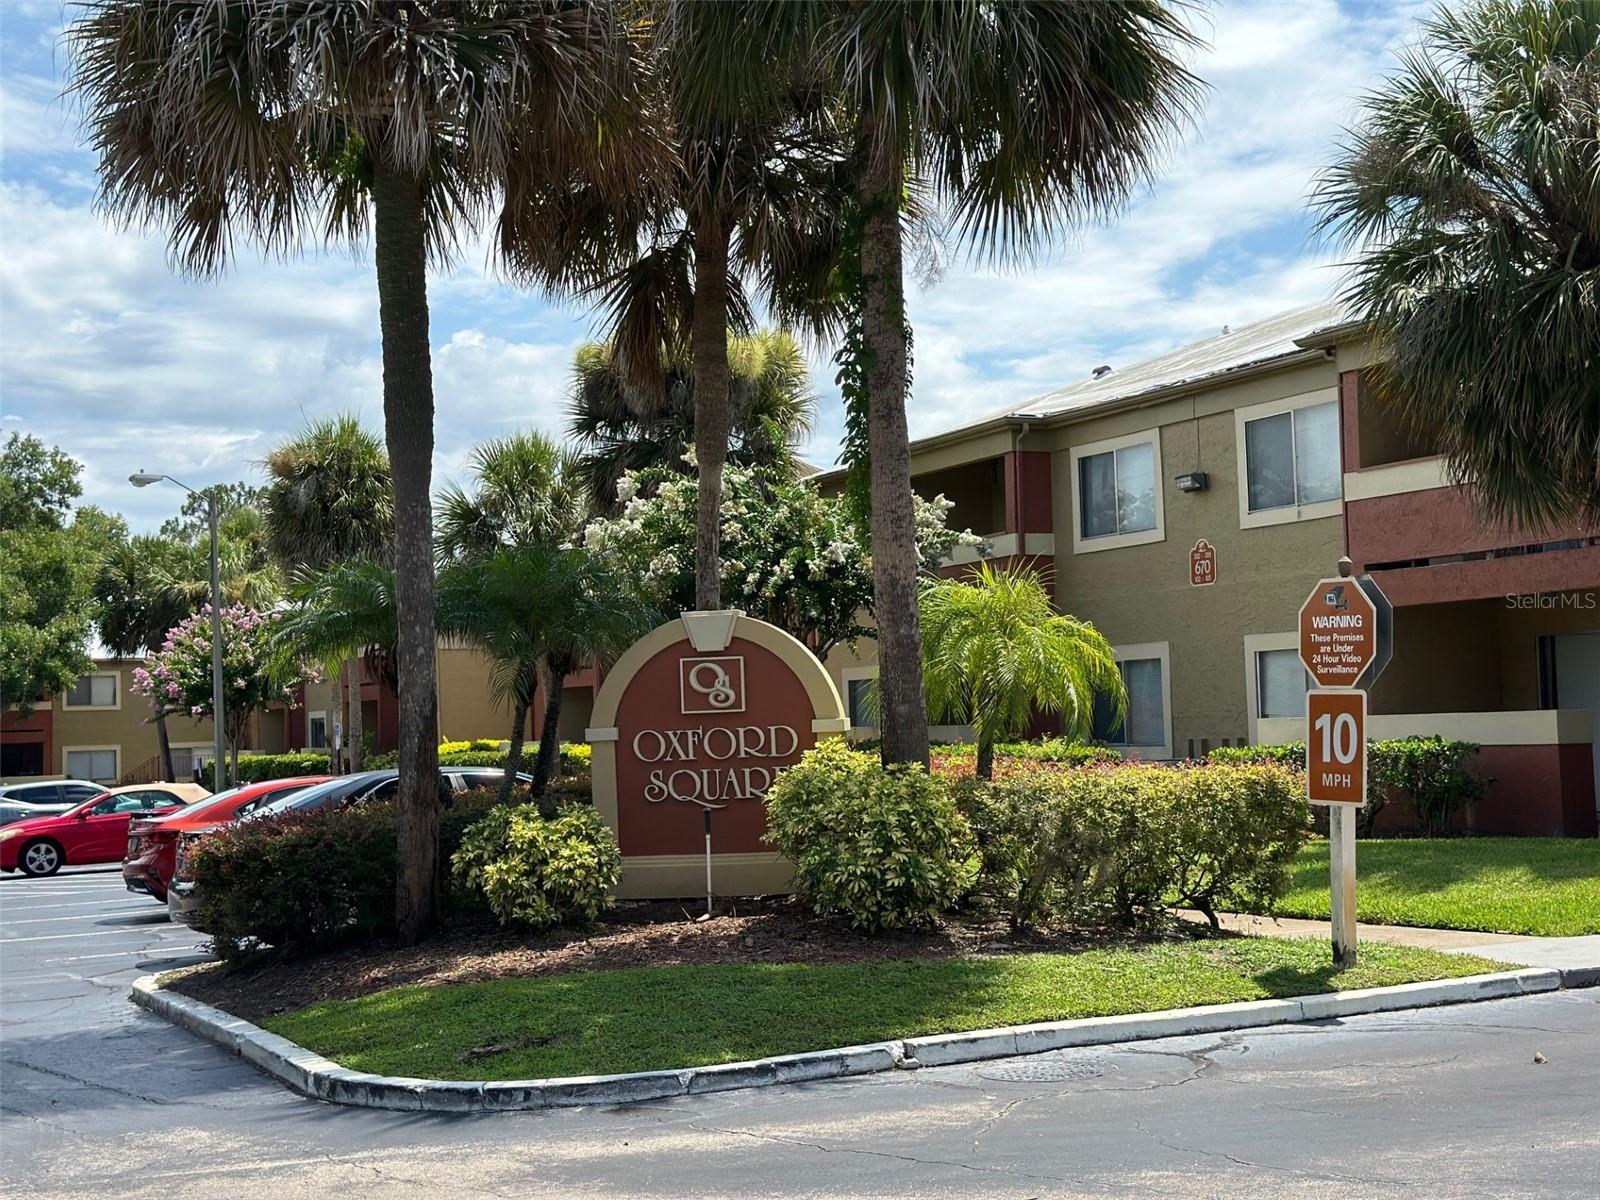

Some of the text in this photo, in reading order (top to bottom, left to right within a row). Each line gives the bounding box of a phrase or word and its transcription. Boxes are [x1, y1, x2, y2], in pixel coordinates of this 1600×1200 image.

[1195, 559, 1211, 575] 670
[1312, 614, 1362, 629] WARNING
[1310, 633, 1364, 642] These Premises
[1333, 644, 1354, 653] Under
[1312, 654, 1362, 663] 24 Hour Video
[1317, 665, 1358, 674] Surveillance
[633, 725, 799, 762] OXFORD
[1315, 712, 1358, 764] 10
[1322, 773, 1351, 788] MPH
